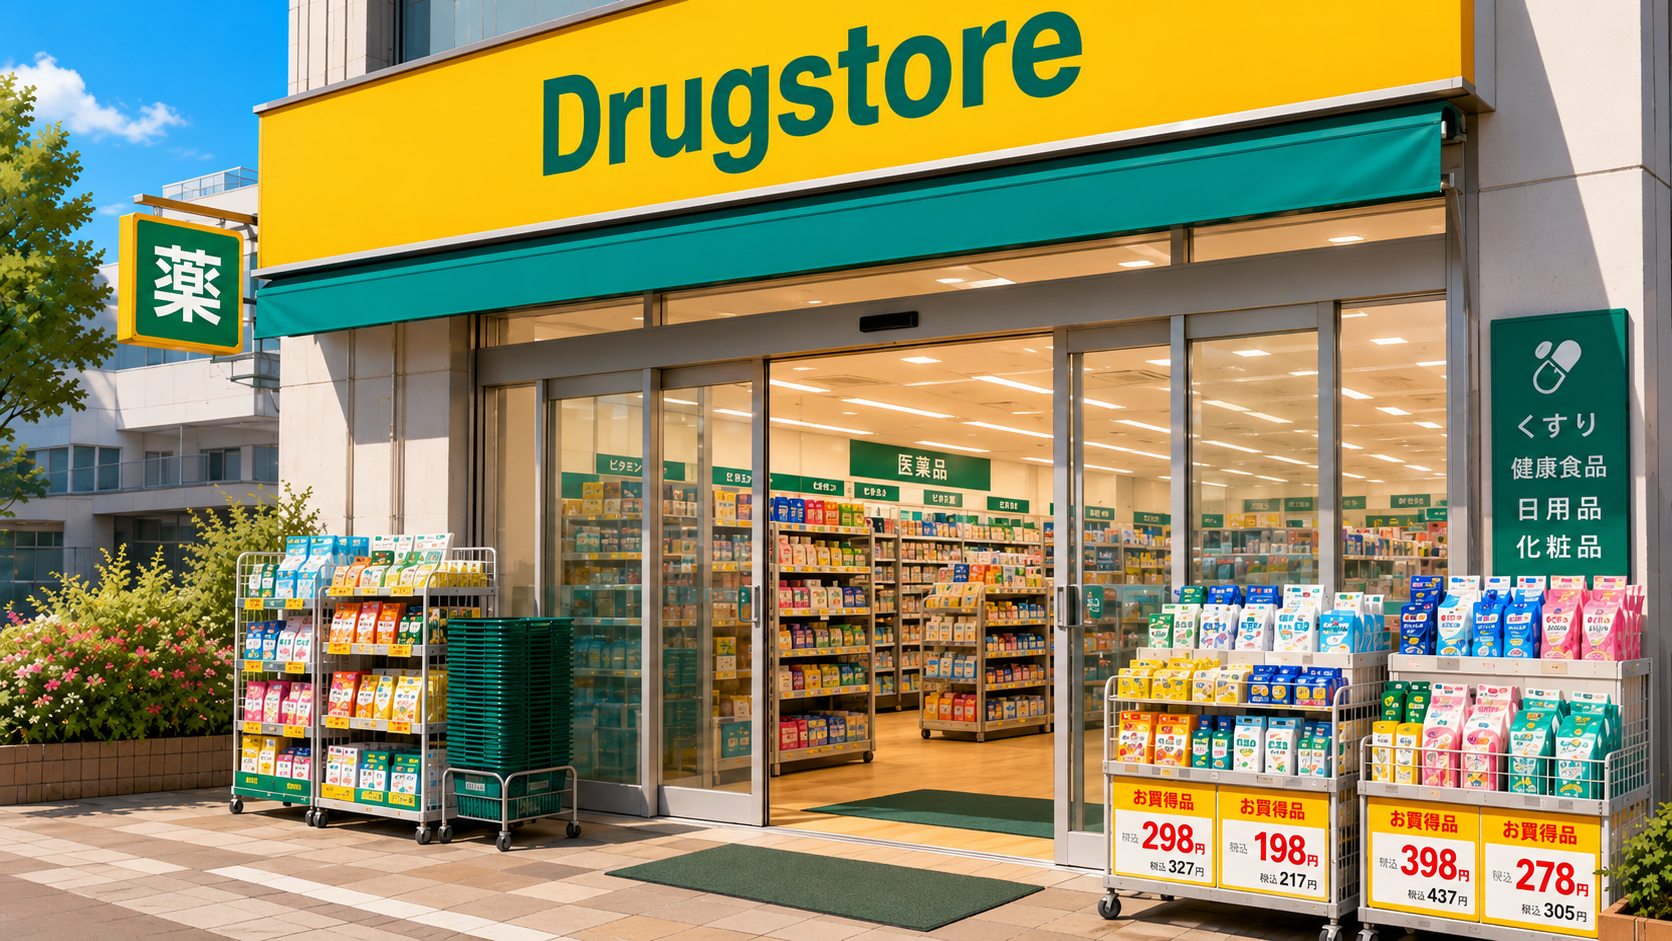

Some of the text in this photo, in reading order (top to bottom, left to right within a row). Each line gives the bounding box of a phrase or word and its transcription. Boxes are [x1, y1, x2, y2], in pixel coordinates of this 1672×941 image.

[543, 11, 1082, 177] Drugstore
[153, 244, 222, 326] 薬
[1518, 412, 1595, 438] くすり
[898, 453, 947, 480] 医薬品
[1511, 455, 1607, 480] 健康食品
[1519, 496, 1601, 520] 日用品
[1516, 535, 1601, 559] 化粧品
[1133, 789, 1194, 811] お買得品
[1240, 798, 1305, 820] お買得品
[1390, 810, 1458, 833] お買得品
[1502, 820, 1577, 845] お買得品
